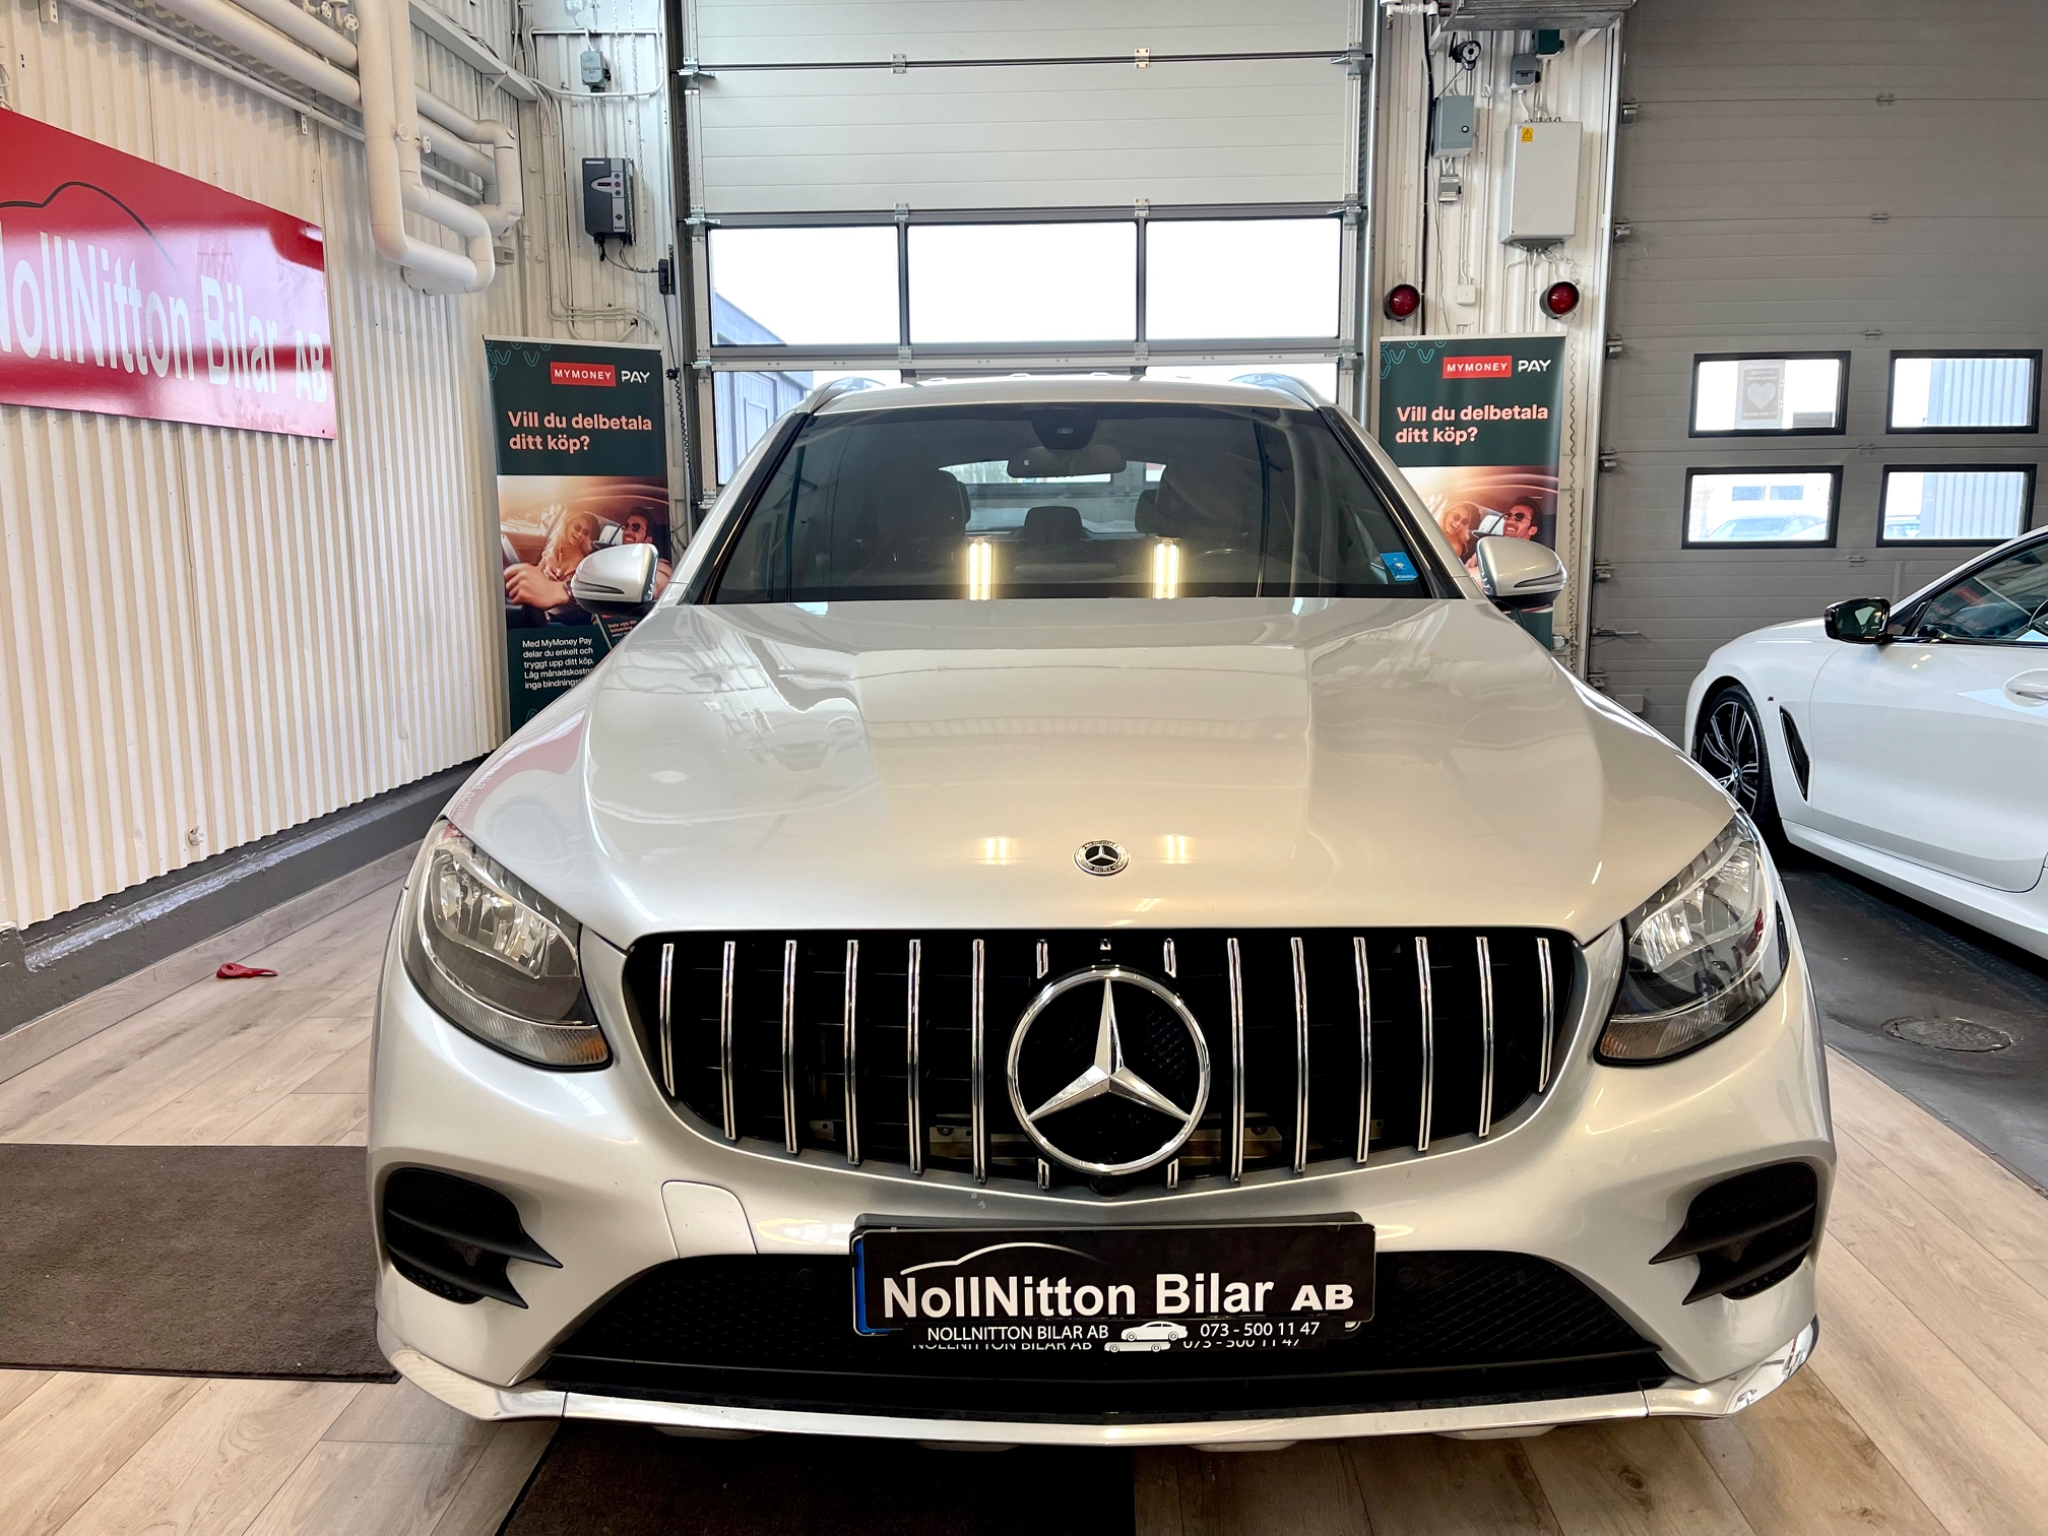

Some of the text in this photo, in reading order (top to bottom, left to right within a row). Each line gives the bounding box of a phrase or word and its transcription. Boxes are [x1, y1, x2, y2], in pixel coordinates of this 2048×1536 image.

[200, 275, 277, 394] Bilar
[295, 329, 327, 402] AB
[1446, 360, 1551, 372] MYMONEY PAY
[554, 369, 650, 383] MYMONEY PAY
[508, 411, 652, 430] Vill du delbetala
[1396, 404, 1548, 422] Vill du delbetala
[1395, 426, 1478, 445] ditt köp?
[509, 433, 590, 454] ditt köp?
[522, 637, 592, 648] Med MyMoney Pay
[524, 661, 547, 669] tryggt
[524, 671, 539, 680] Låg
[525, 682, 542, 690] inga
[883, 1273, 1354, 1318] NollNitton Bilar AB
[928, 1325, 1109, 1341] NOLLNITTON BILAR AB
[1200, 1323, 1229, 1337] 073
[1243, 1322, 1273, 1336] 500
[1278, 1322, 1293, 1336] 11
[1300, 1322, 1320, 1335] 47
